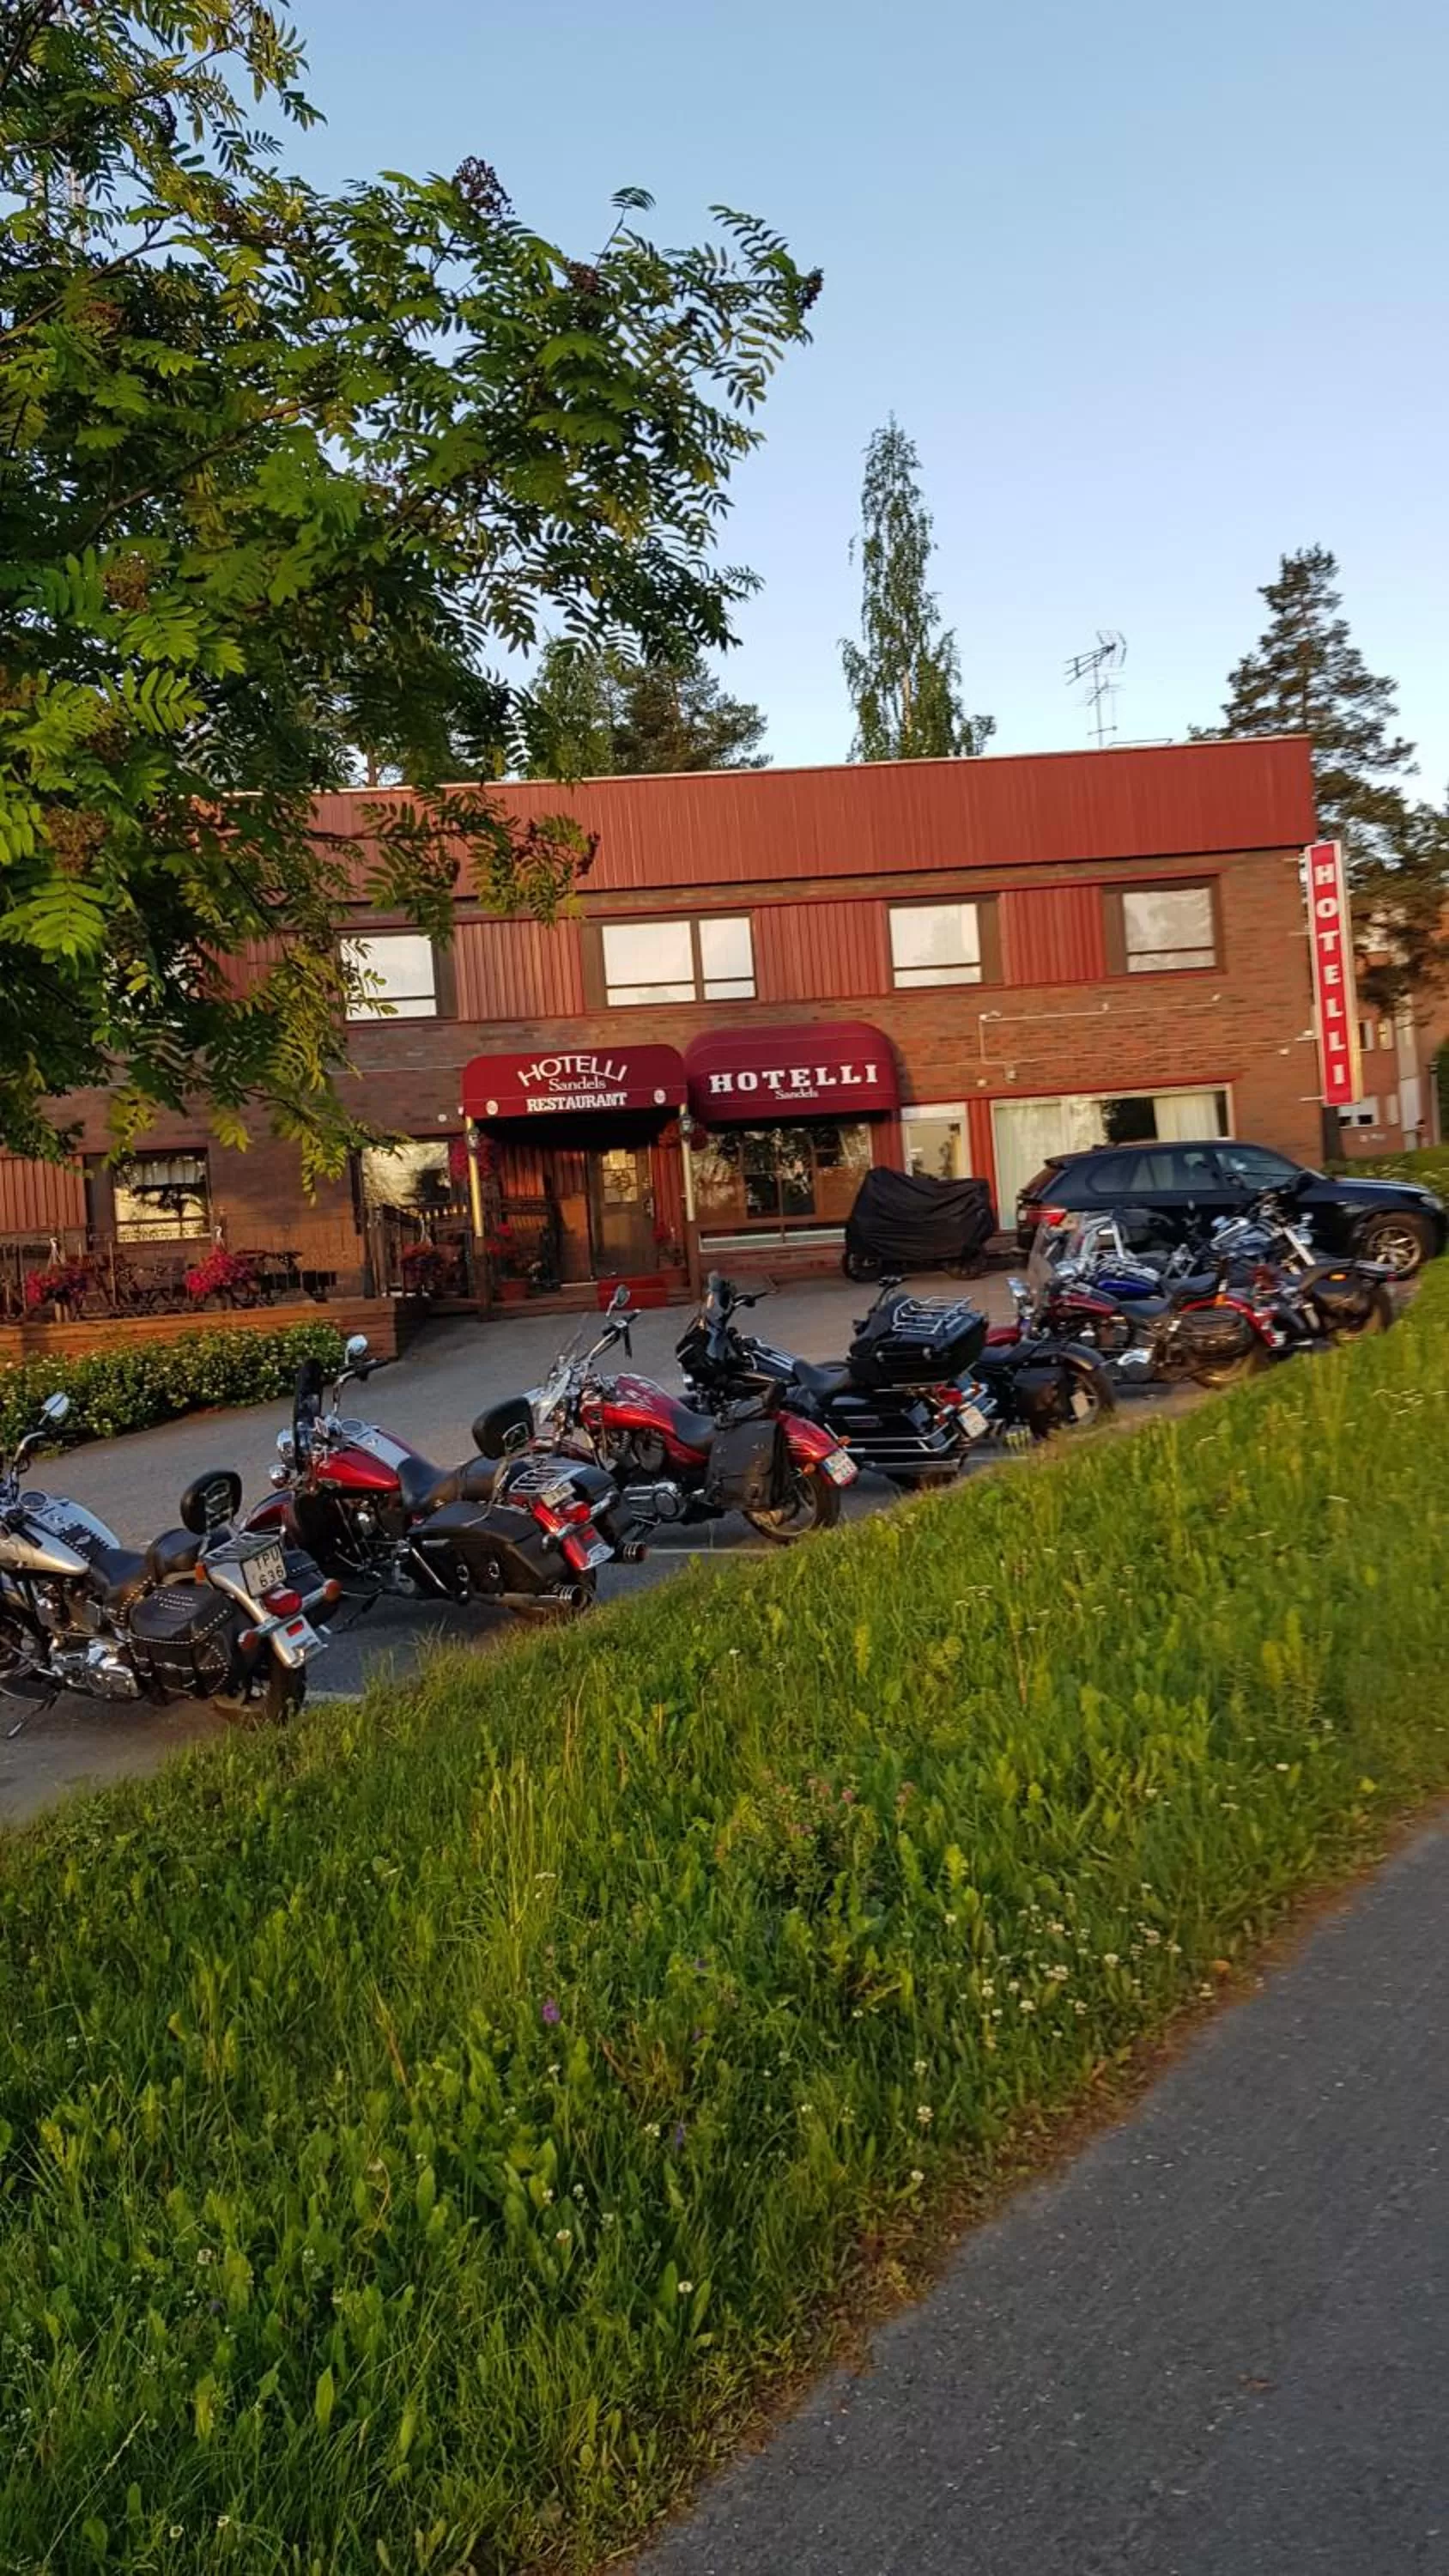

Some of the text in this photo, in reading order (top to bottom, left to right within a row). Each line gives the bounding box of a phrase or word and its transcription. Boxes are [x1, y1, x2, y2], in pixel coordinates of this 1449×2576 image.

[1314, 864, 1345, 1085] HOTELLI
[517, 1055, 627, 1087] HOTELLI
[549, 1075, 606, 1091] Sandels
[709, 1064, 878, 1093] HOTELLI
[525, 1092, 627, 1112] RESTAURANT
[774, 1087, 819, 1100] Sandels
[259, 1564, 284, 1588] 636
